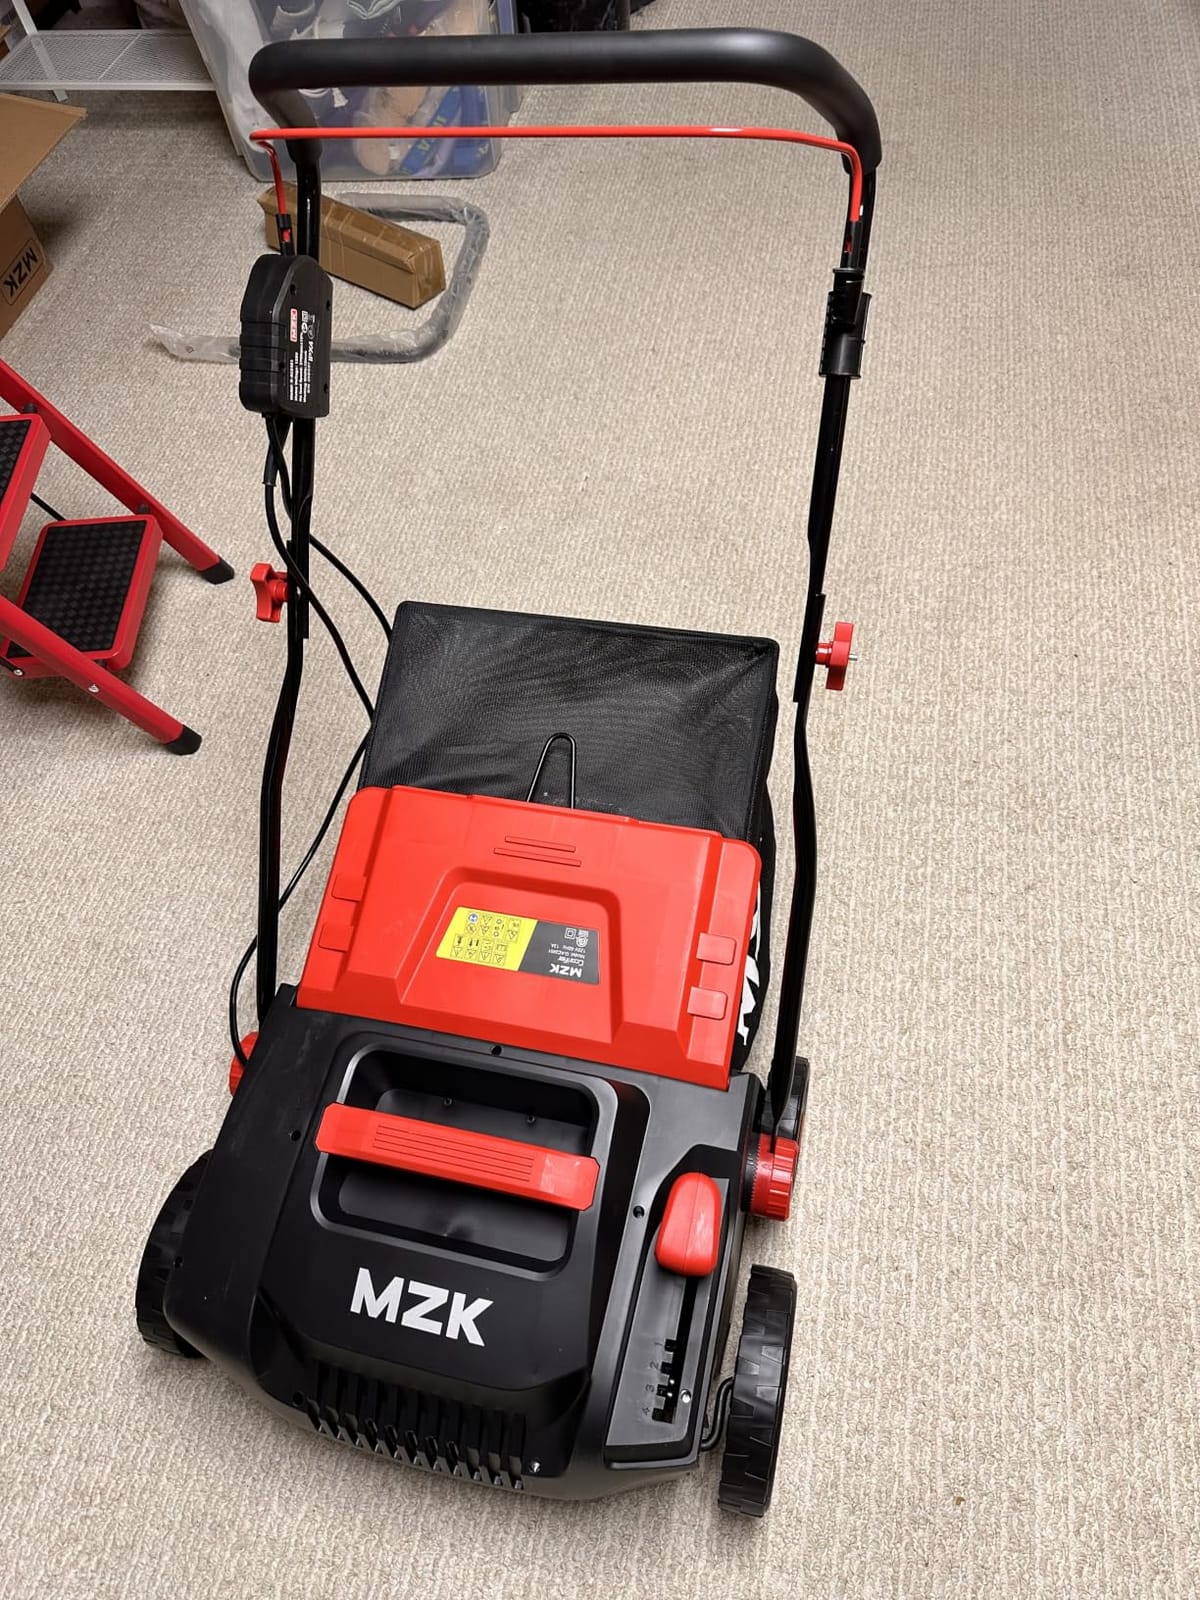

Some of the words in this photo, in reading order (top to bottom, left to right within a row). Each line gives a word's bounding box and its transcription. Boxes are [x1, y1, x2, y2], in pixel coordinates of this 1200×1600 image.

[3, 247, 38, 297] MZK
[550, 963, 583, 978] MZK
[350, 1267, 494, 1347] MZK
[649, 1361, 660, 1371] 2
[645, 1384, 655, 1393] 3
